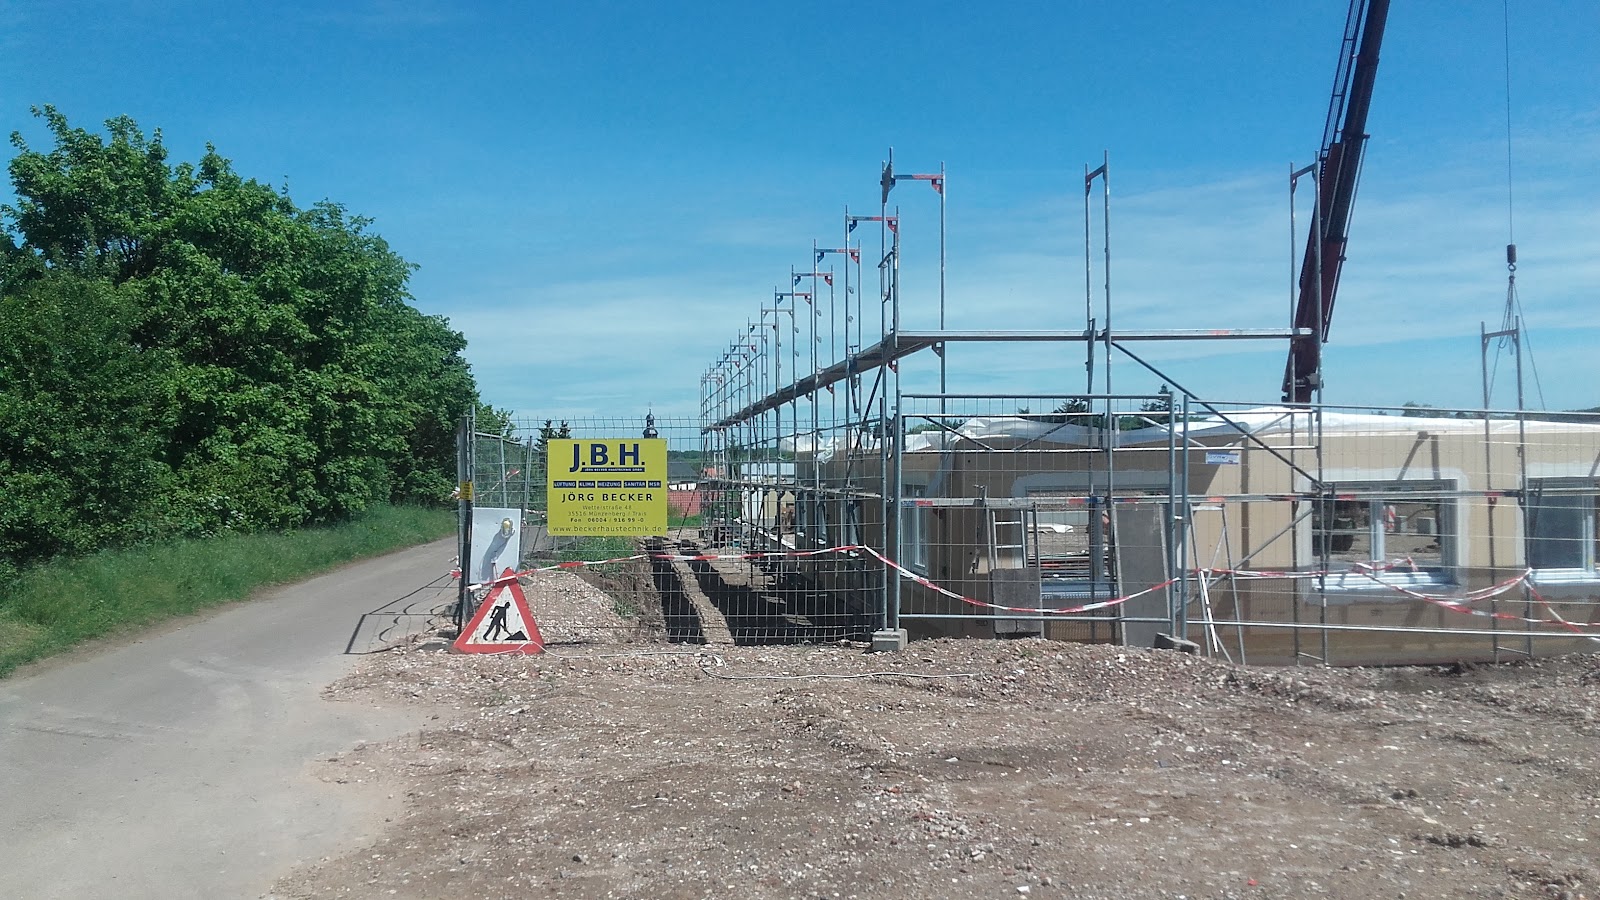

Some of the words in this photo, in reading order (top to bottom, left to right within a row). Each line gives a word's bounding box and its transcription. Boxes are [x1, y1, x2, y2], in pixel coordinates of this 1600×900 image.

[569, 443, 645, 472] J.B.H.
[561, 491, 595, 503] JÖRG
[602, 493, 653, 502] BECKER
